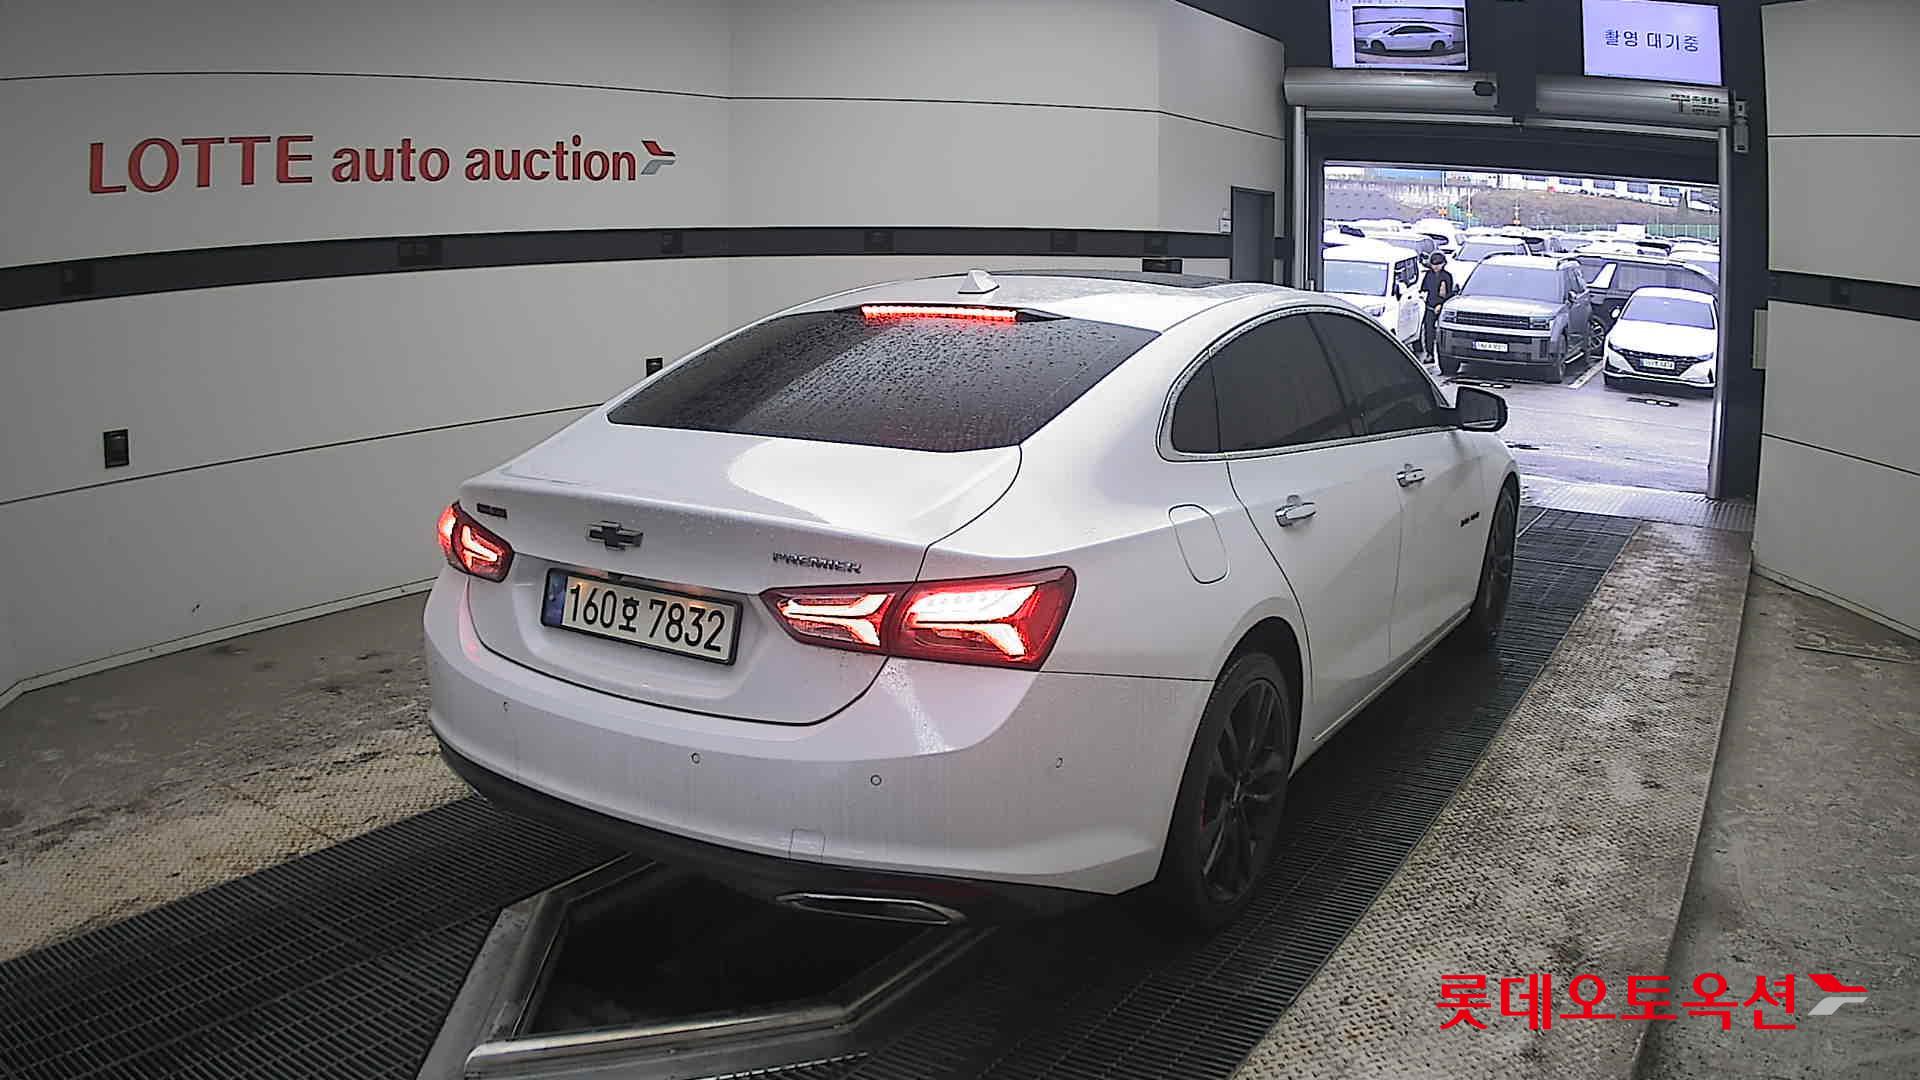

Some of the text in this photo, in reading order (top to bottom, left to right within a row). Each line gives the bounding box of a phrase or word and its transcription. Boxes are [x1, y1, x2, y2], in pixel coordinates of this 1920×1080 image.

[1604, 29, 1699, 53] 촬영 대기중
[88, 134, 637, 194] LOTTE auto auction
[772, 551, 863, 575] PREMIER
[649, 597, 726, 653] 7832
